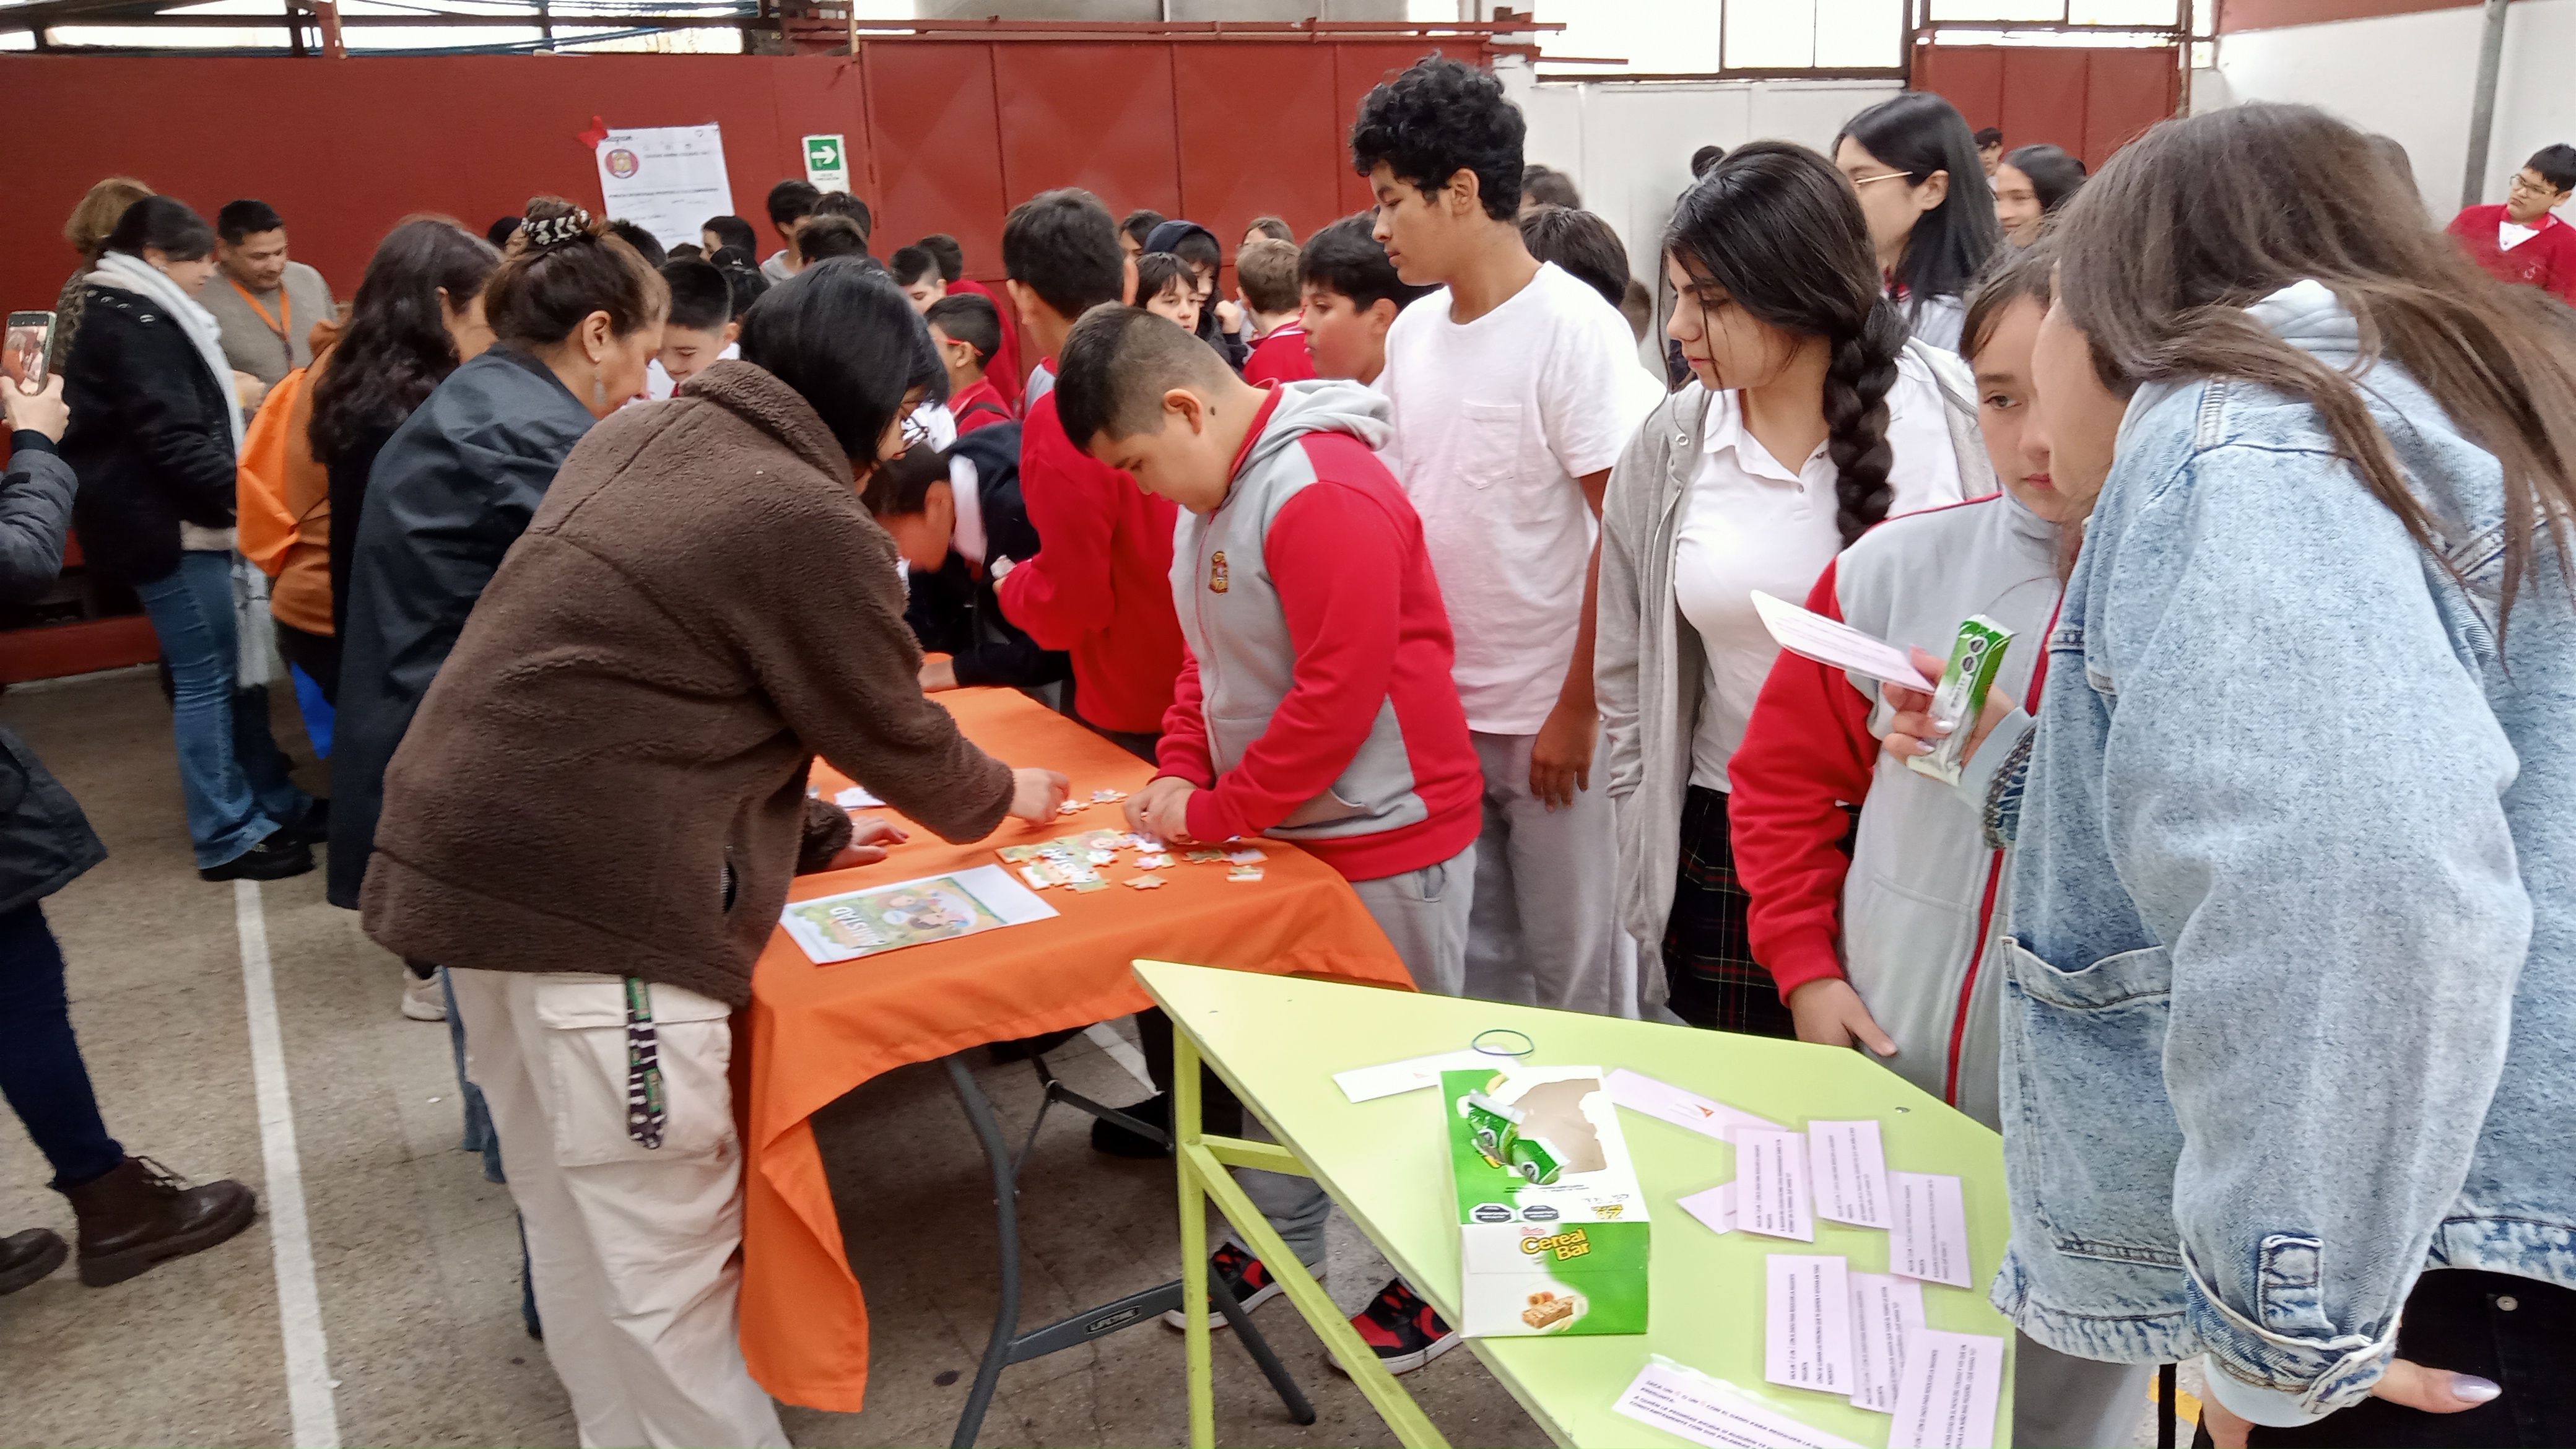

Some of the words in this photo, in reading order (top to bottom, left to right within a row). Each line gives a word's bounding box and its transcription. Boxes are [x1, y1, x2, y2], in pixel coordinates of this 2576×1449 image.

[830, 906, 886, 946] AMISTAD
[1521, 1227, 1588, 1255] Cereal
[1555, 1242, 1591, 1261] Bar
